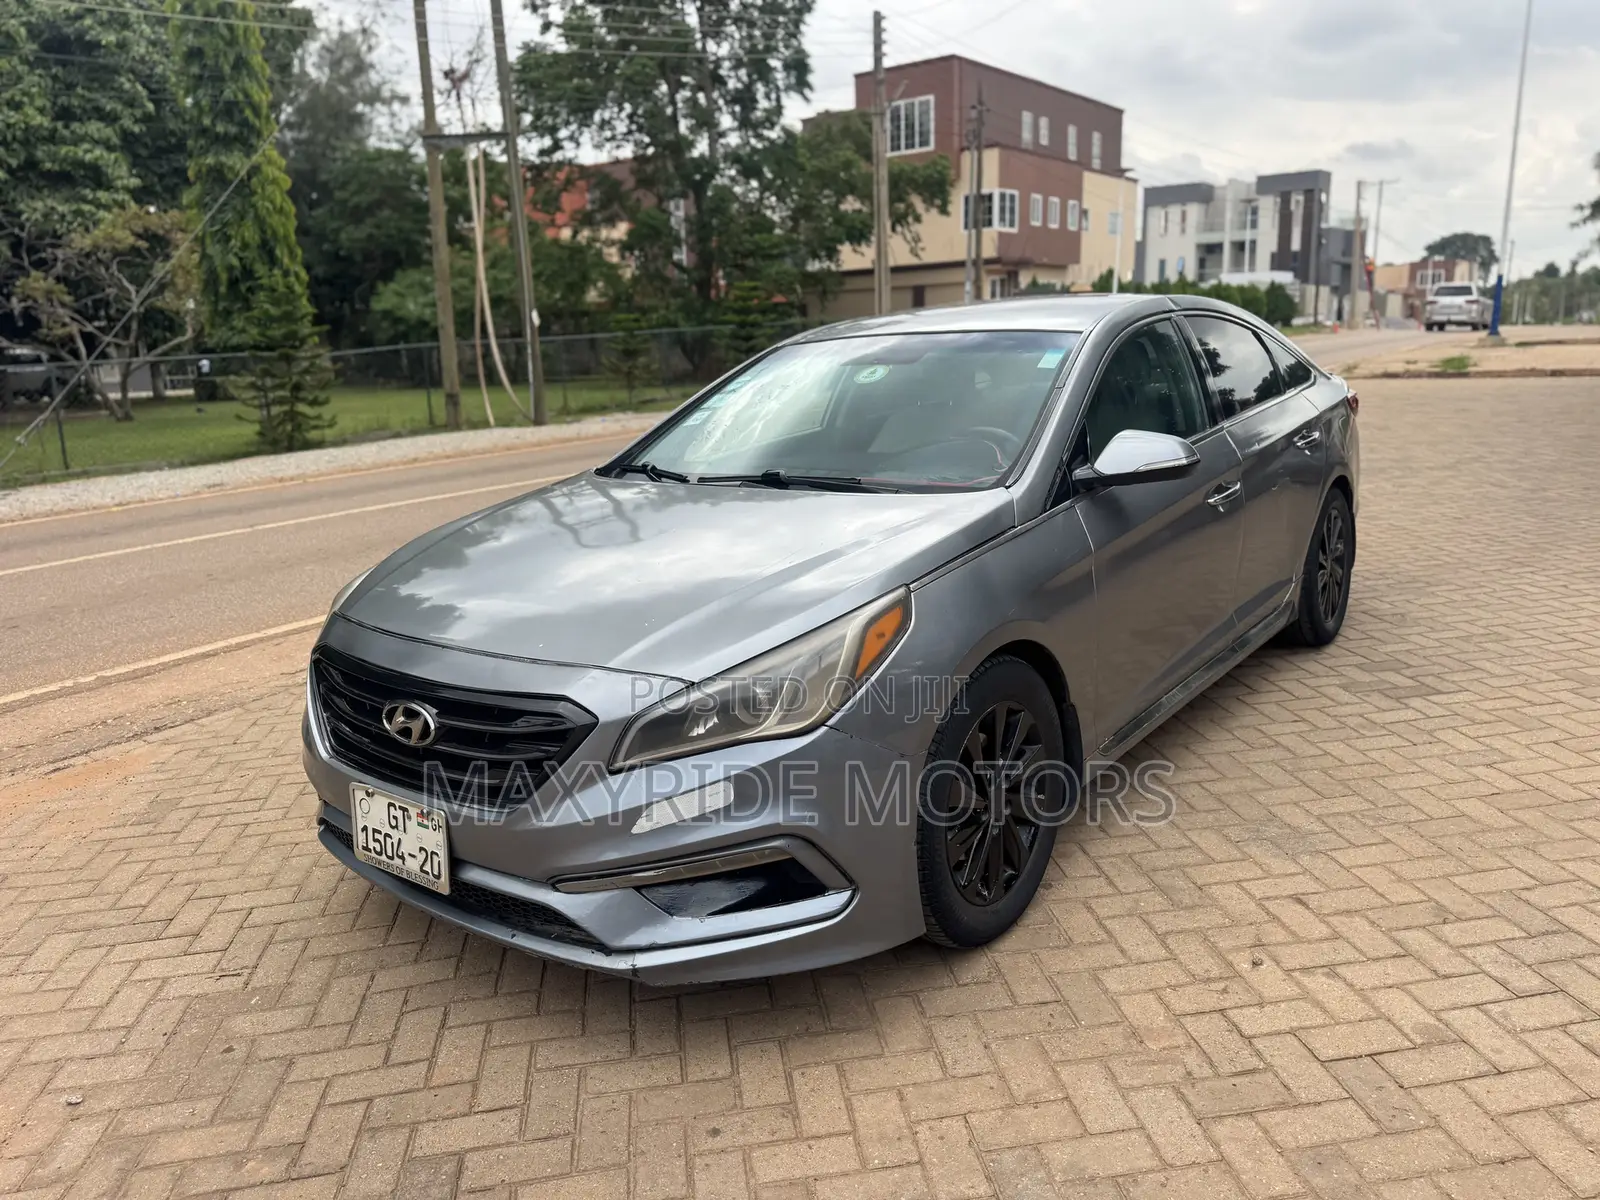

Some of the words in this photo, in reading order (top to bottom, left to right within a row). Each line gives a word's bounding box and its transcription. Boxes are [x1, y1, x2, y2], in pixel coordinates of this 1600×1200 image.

[387, 802, 410, 833] GT
[361, 825, 442, 880] 1504-20
[363, 854, 395, 873] SHOWERS
[395, 866, 405, 876] OF
[406, 870, 439, 890] BLESSING
